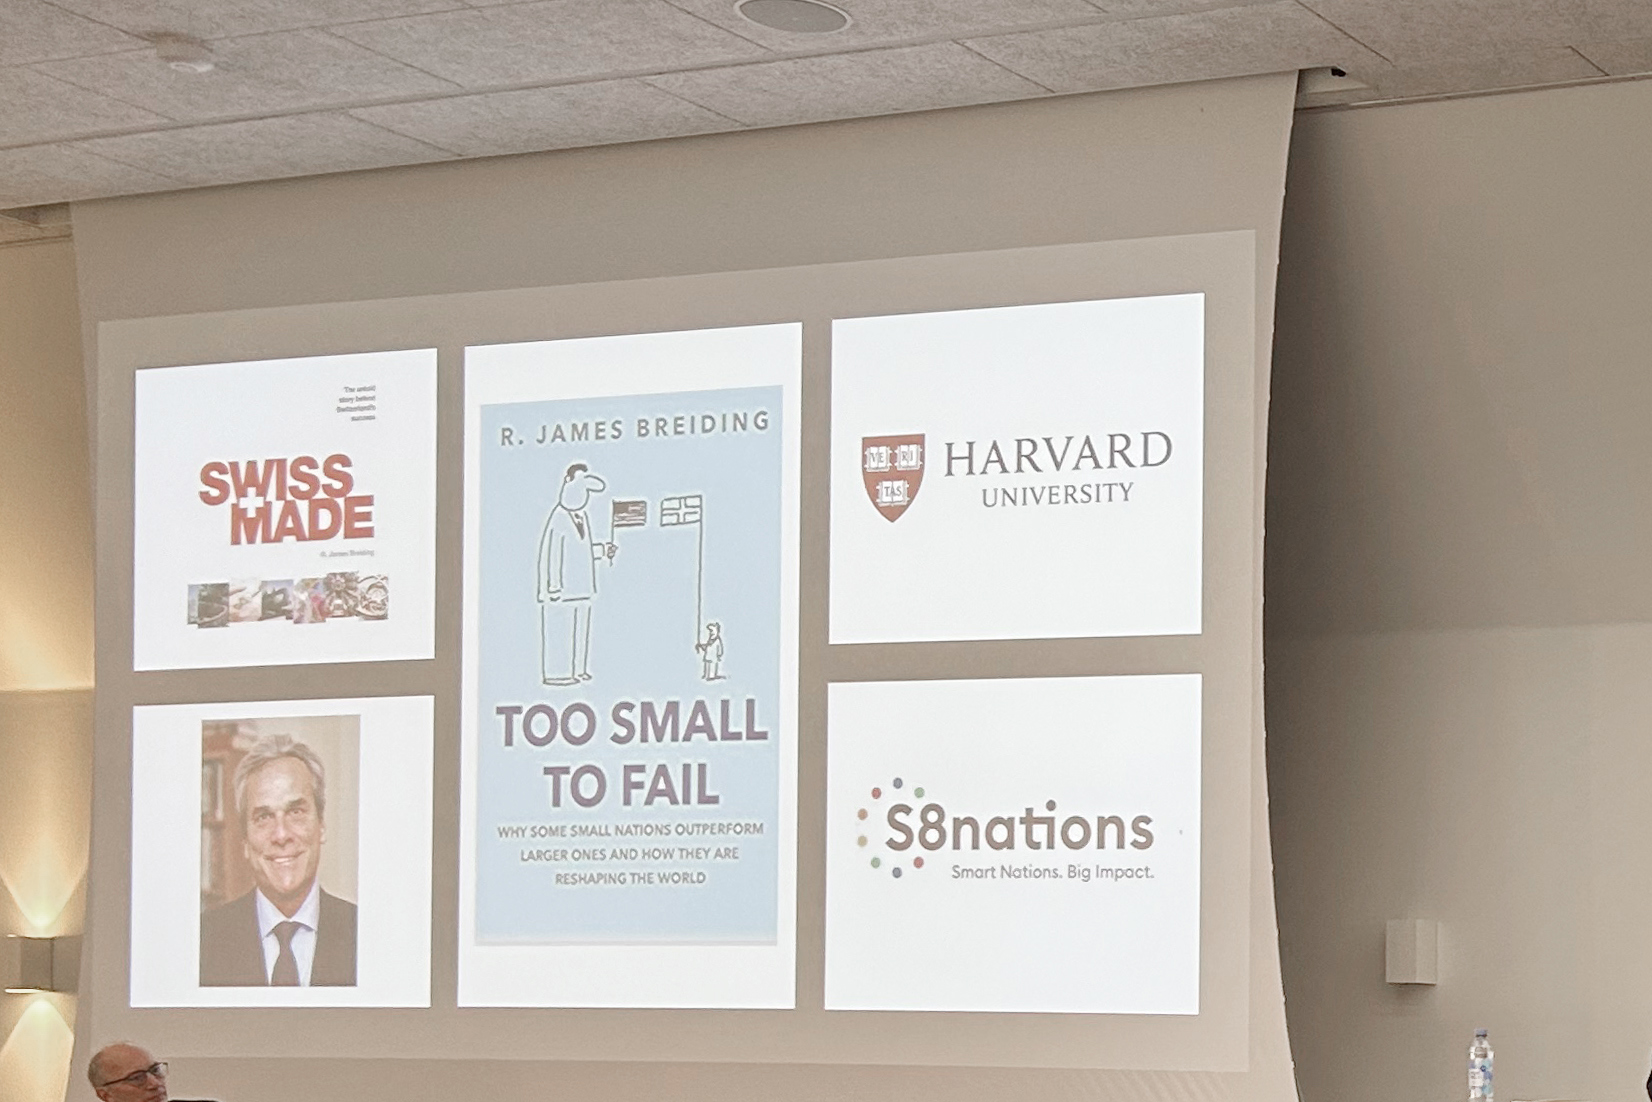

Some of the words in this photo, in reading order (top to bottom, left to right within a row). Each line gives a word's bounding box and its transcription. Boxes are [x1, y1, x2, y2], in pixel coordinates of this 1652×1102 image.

[500, 427, 525, 447] R.
[535, 419, 623, 445] JAMES
[636, 410, 769, 438] BREIDING
[944, 431, 1173, 477] HARVARD
[198, 453, 354, 506] SWISS
[982, 482, 1134, 508] UNIVERSITY
[231, 495, 375, 545] MADE
[496, 702, 598, 748] TOO
[609, 698, 770, 743] SMALL
[543, 764, 608, 808] TO
[622, 762, 720, 806] FAIL
[498, 826, 527, 839] WHY
[530, 825, 566, 838] SOME
[570, 824, 611, 837] SMALL
[614, 823, 672, 837] NATIONS
[675, 822, 764, 836] OUTPERFORM
[885, 799, 1154, 851] S8nations
[520, 849, 568, 862] LARGER
[571, 849, 606, 861] ONES
[609, 848, 638, 861] AND
[642, 848, 675, 860] HOW
[678, 847, 712, 860] THEY
[714, 847, 740, 859] ARE
[951, 864, 997, 879] Smart
[1000, 864, 1063, 879] Nations.
[1067, 864, 1091, 883] Big
[1095, 864, 1155, 882] Impact.
[555, 872, 627, 885] RESHAPING
[629, 872, 654, 884] THE
[657, 871, 706, 885] WORLD
